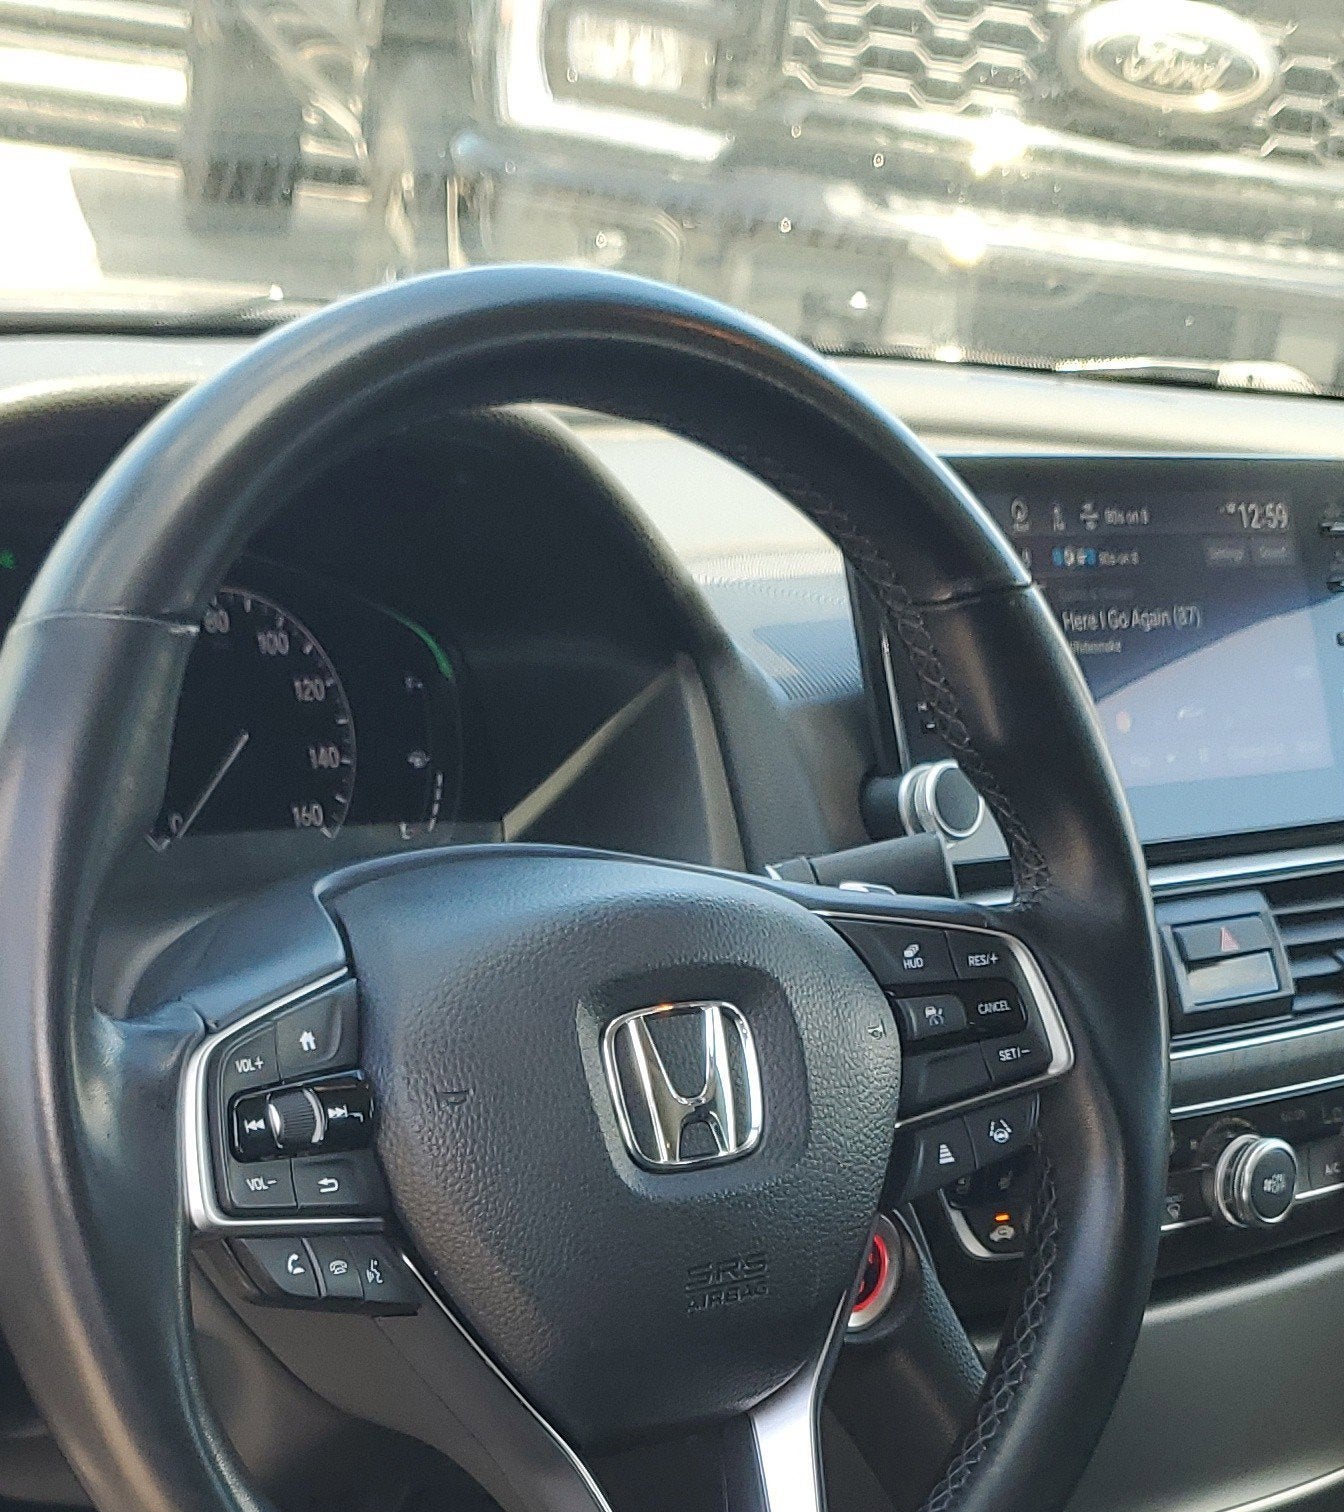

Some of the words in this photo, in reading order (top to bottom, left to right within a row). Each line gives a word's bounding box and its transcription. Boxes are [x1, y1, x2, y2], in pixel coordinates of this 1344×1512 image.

[1061, 609, 1099, 632] Here
[1107, 605, 1130, 631] Go
[1131, 605, 1172, 633] Again
[257, 631, 290, 656] 100
[294, 677, 326, 702] 120
[309, 745, 340, 770] 140
[293, 803, 324, 828] 160
[977, 999, 1012, 1015] CANCEL
